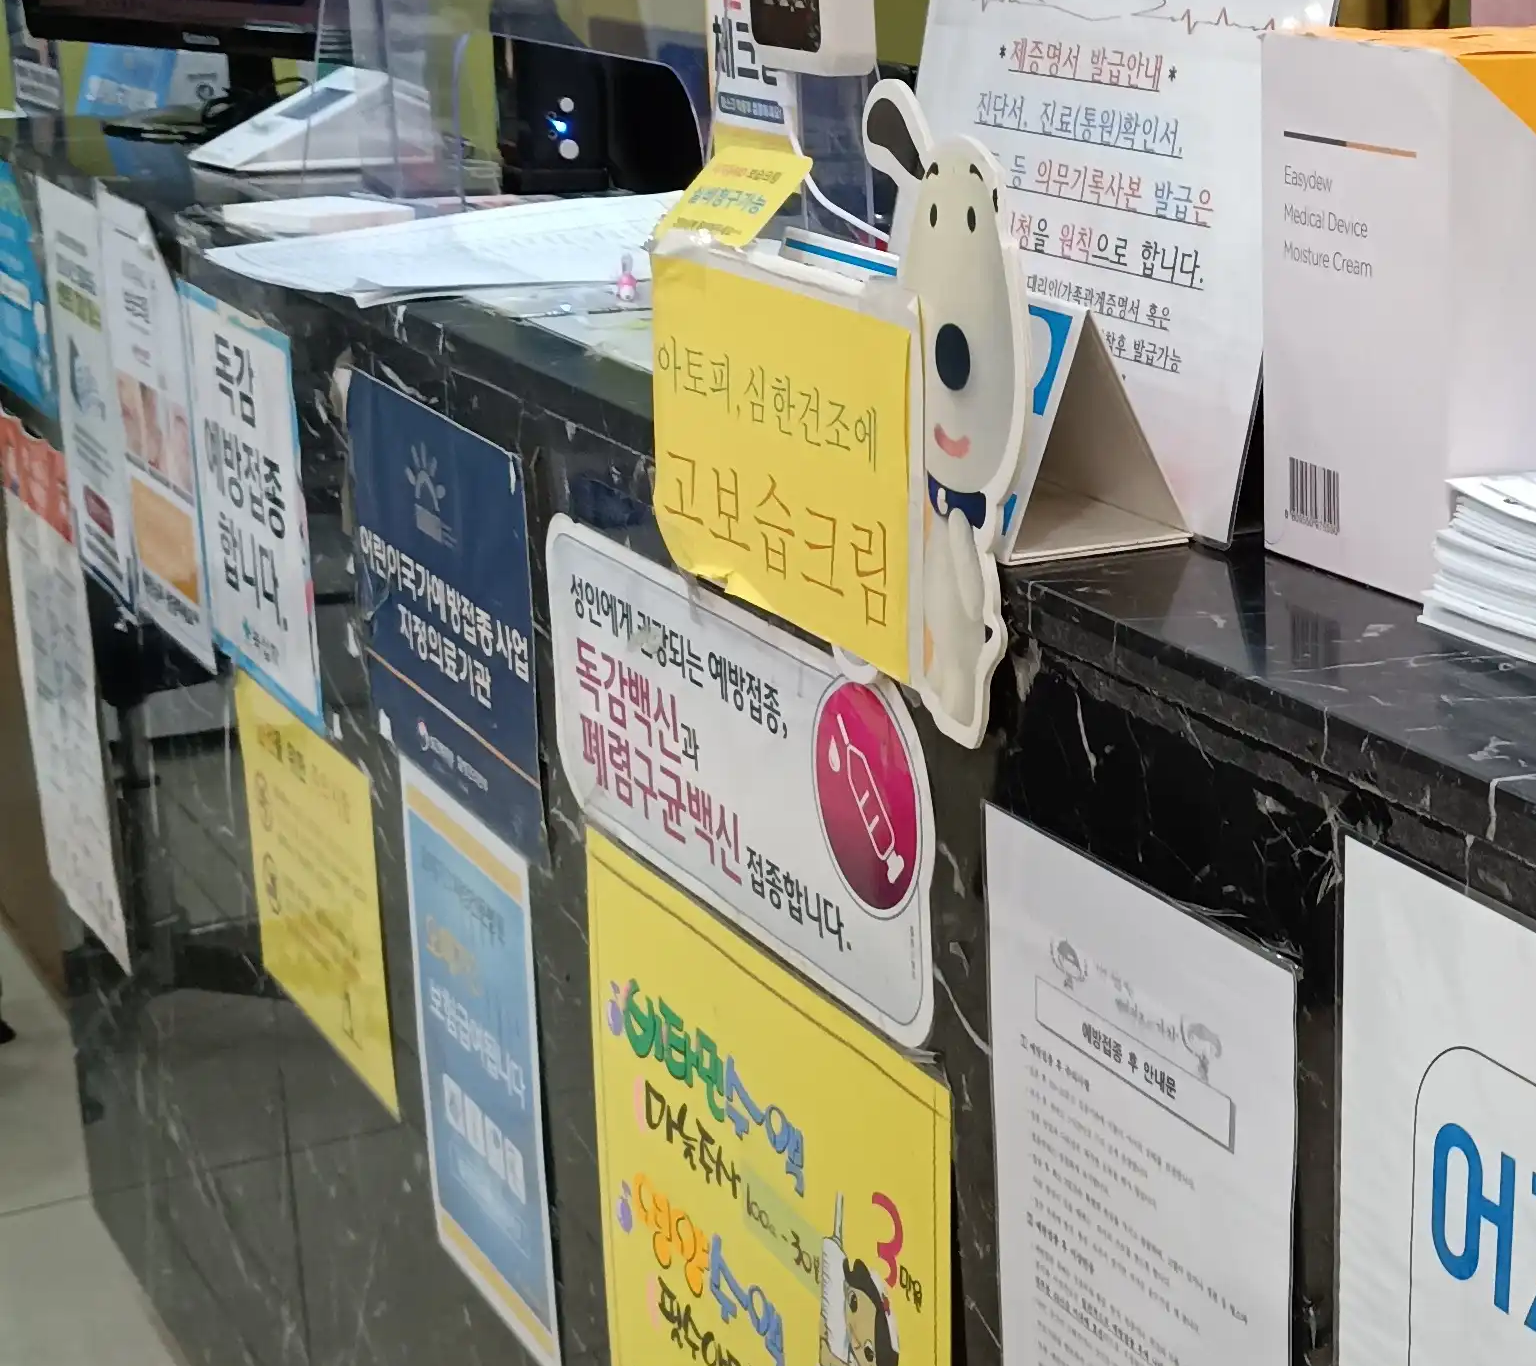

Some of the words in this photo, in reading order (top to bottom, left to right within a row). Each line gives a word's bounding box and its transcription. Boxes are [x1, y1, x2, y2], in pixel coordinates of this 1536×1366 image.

[1009, 37, 1081, 79] 제증명서
[1089, 47, 1164, 92] 발급안내
[1010, 155, 1027, 190] 등
[1035, 159, 1143, 213] 의무기록사본
[1153, 180, 1214, 226] 발급은
[1284, 164, 1333, 193] Easydew
[1009, 211, 1051, 253] 청을
[1058, 223, 1129, 270] 원칙으로
[1140, 240, 1205, 289] 합니다.
[1283, 239, 1330, 269] Moisture
[1332, 251, 1373, 279] Cream
[1284, 202, 1325, 230] Medical
[1328, 211, 1368, 239] Device
[1132, 337, 1183, 374] 발급가능
[1145, 302, 1172, 331] 혹은
[213, 331, 259, 430] 독감
[203, 416, 287, 541] 예방접종
[217, 510, 289, 633] 합니다.
[569, 572, 635, 643] 성인에게
[706, 652, 790, 740] 예방접종,
[574, 635, 701, 772] 독감백신과
[578, 711, 743, 887] 폐렴구균백신
[745, 844, 853, 955] 접종합니다.
[1080, 1021, 1124, 1066] 예방접종
[1127, 1050, 1139, 1074] 후
[1142, 1059, 1178, 1101] 안내문
[644, 1078, 741, 1200] 마늘주사
